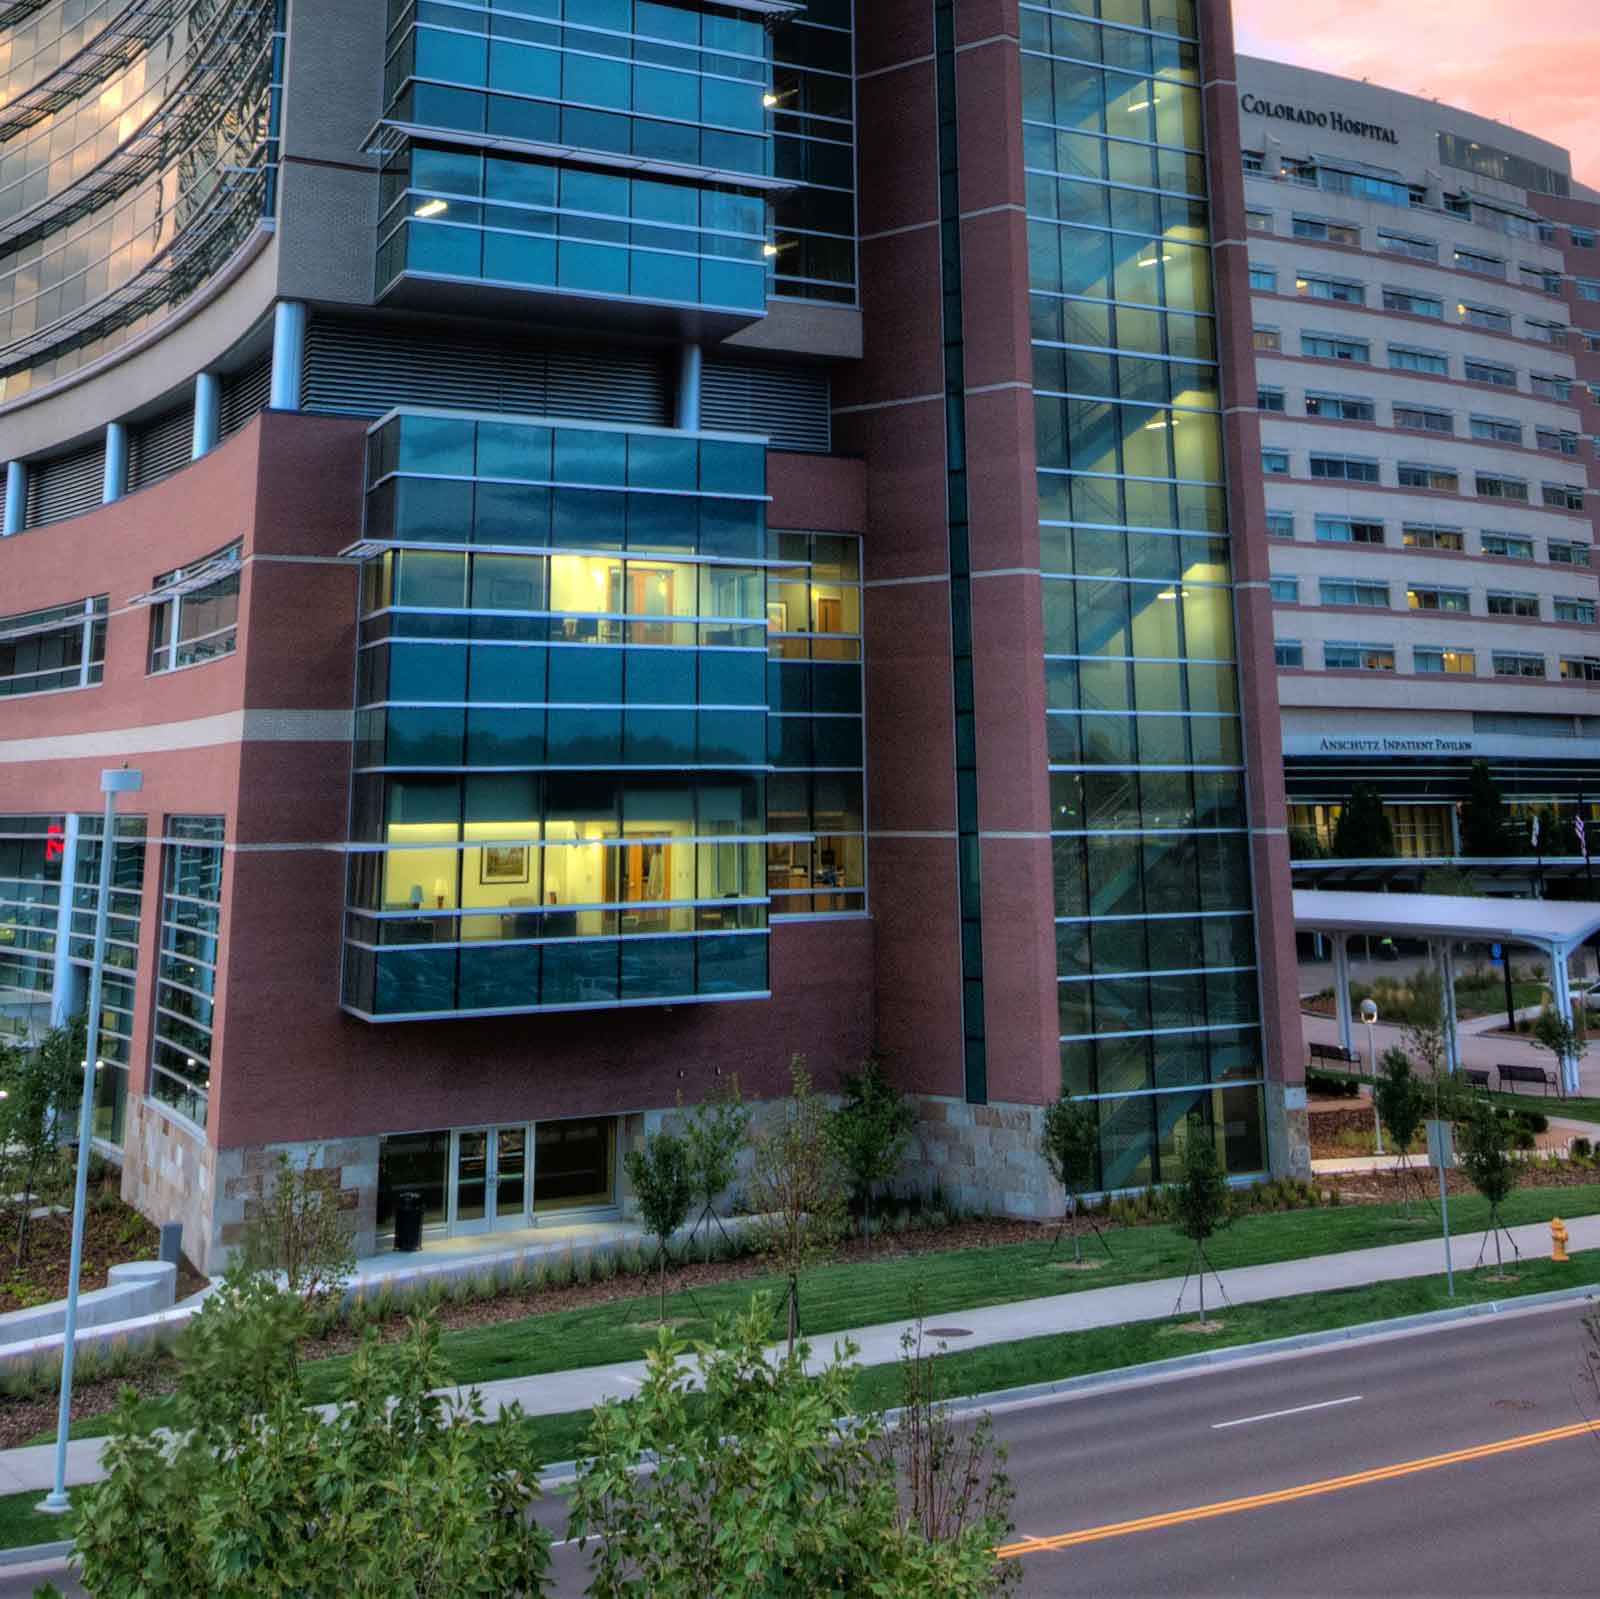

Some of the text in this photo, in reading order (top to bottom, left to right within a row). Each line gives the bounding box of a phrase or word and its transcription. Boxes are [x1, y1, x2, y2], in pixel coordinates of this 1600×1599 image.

[1241, 93, 1399, 145] COLORADO HOSPITAL
[1320, 737, 1379, 751] ANSCHUTZ
[1383, 738, 1433, 751] INPATIENT
